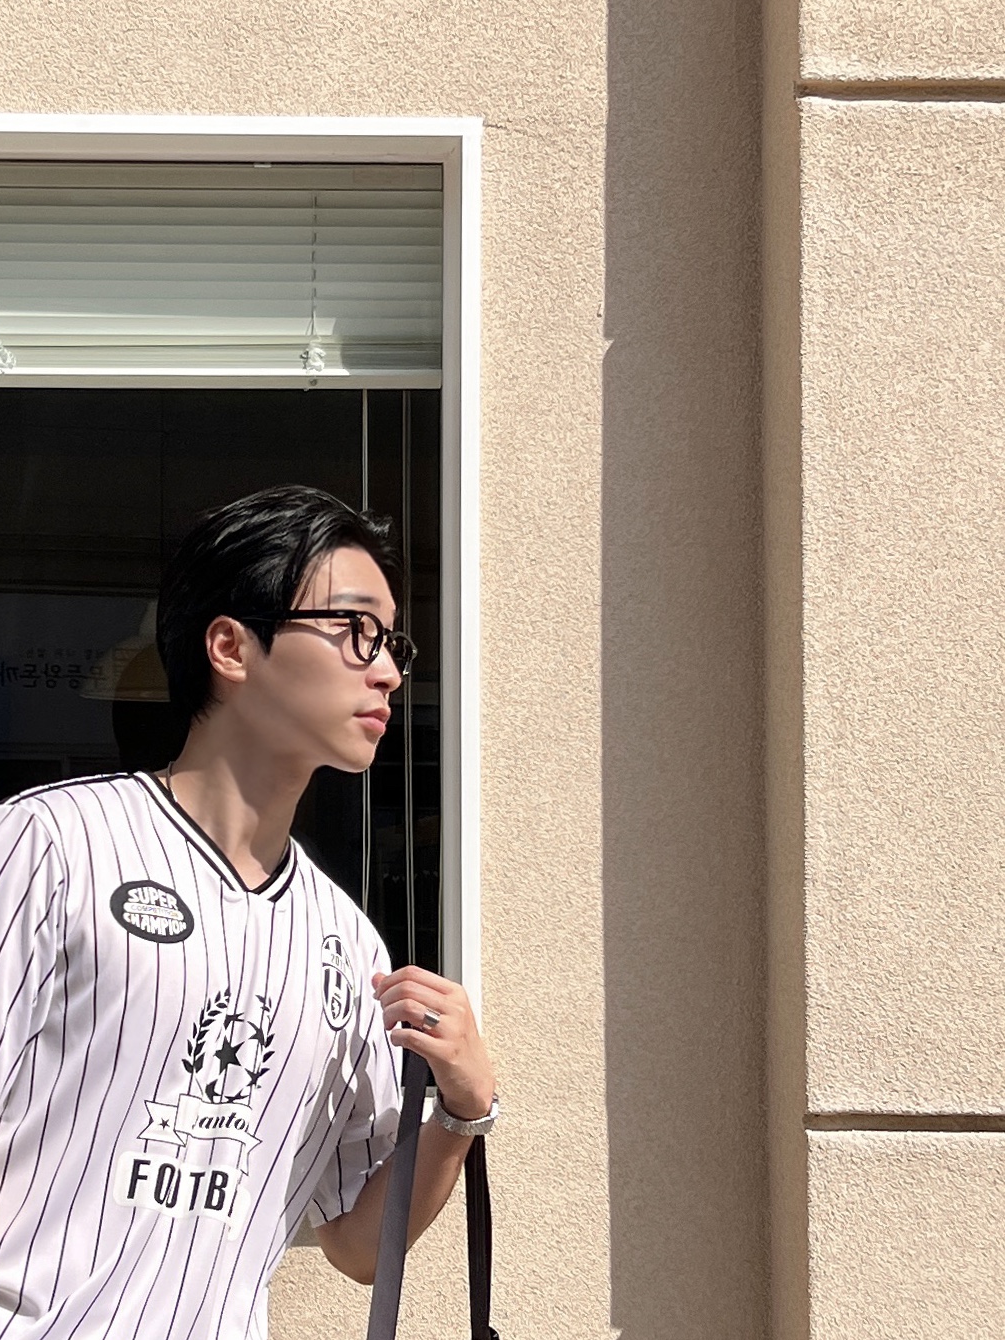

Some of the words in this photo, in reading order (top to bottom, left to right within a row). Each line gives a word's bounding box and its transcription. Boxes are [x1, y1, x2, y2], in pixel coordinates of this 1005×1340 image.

[127, 886, 179, 911] SUPER
[122, 911, 188, 937] CHAMPION
[191, 1111, 250, 1133] anto
